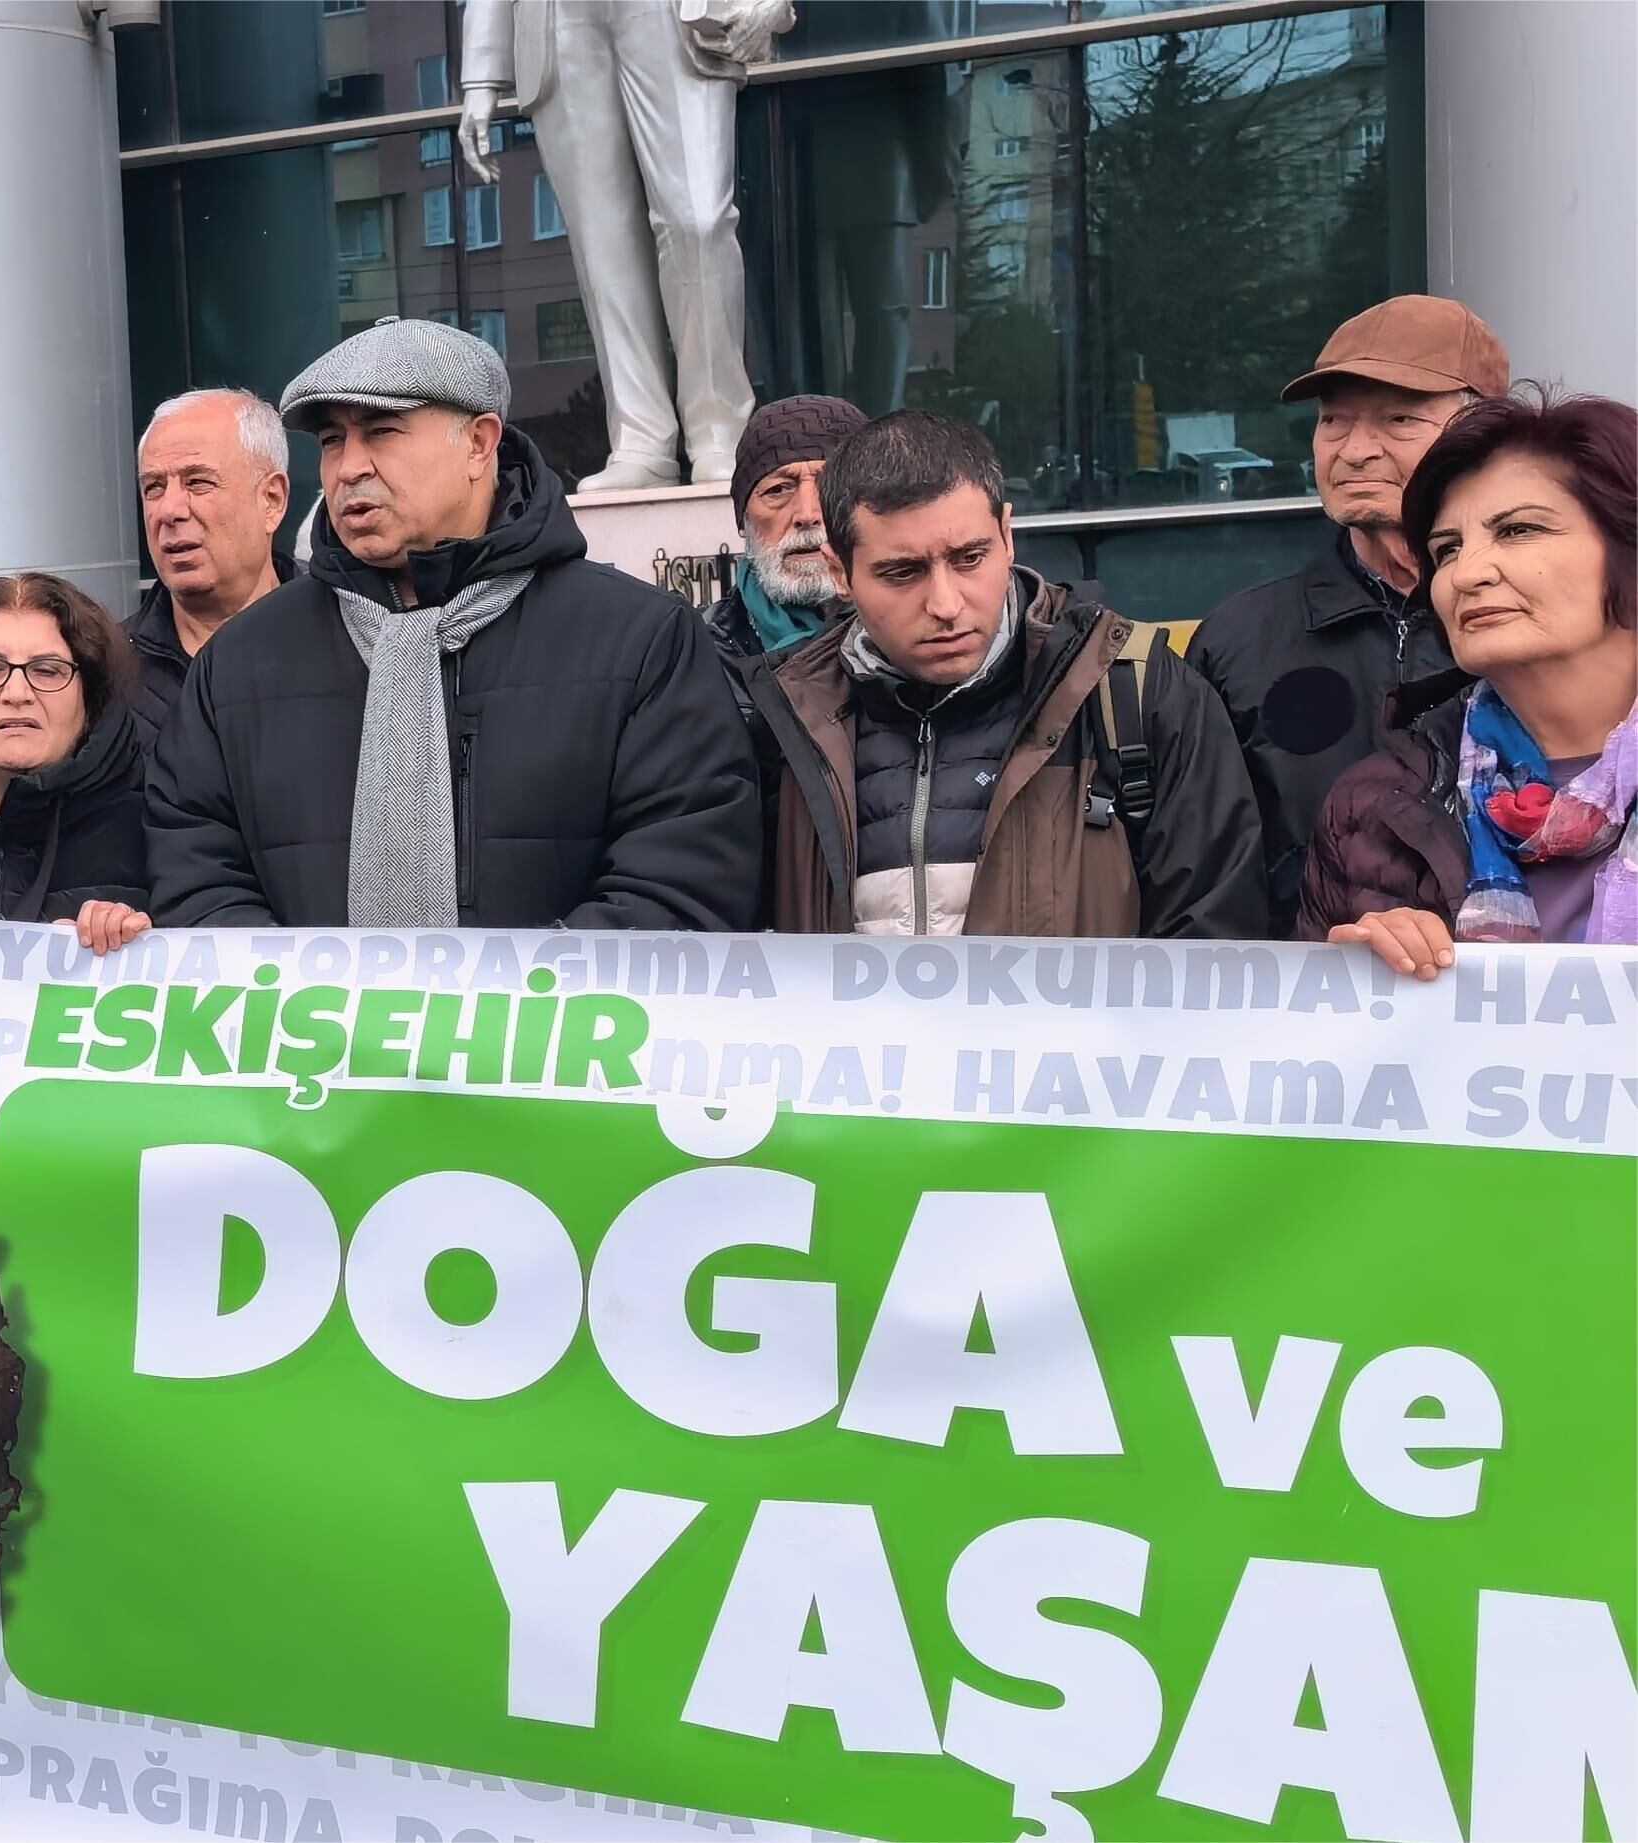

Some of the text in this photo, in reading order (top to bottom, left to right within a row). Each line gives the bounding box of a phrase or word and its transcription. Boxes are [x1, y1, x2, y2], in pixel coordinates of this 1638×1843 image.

[24, 964, 650, 1107] ESKİŞEHİR
[1454, 954, 1638, 1025] HA
[953, 1049, 1430, 1132] HAVAMA
[1465, 1065, 1638, 1144] SU
[133, 1088, 1503, 1518] DOĞA ve
